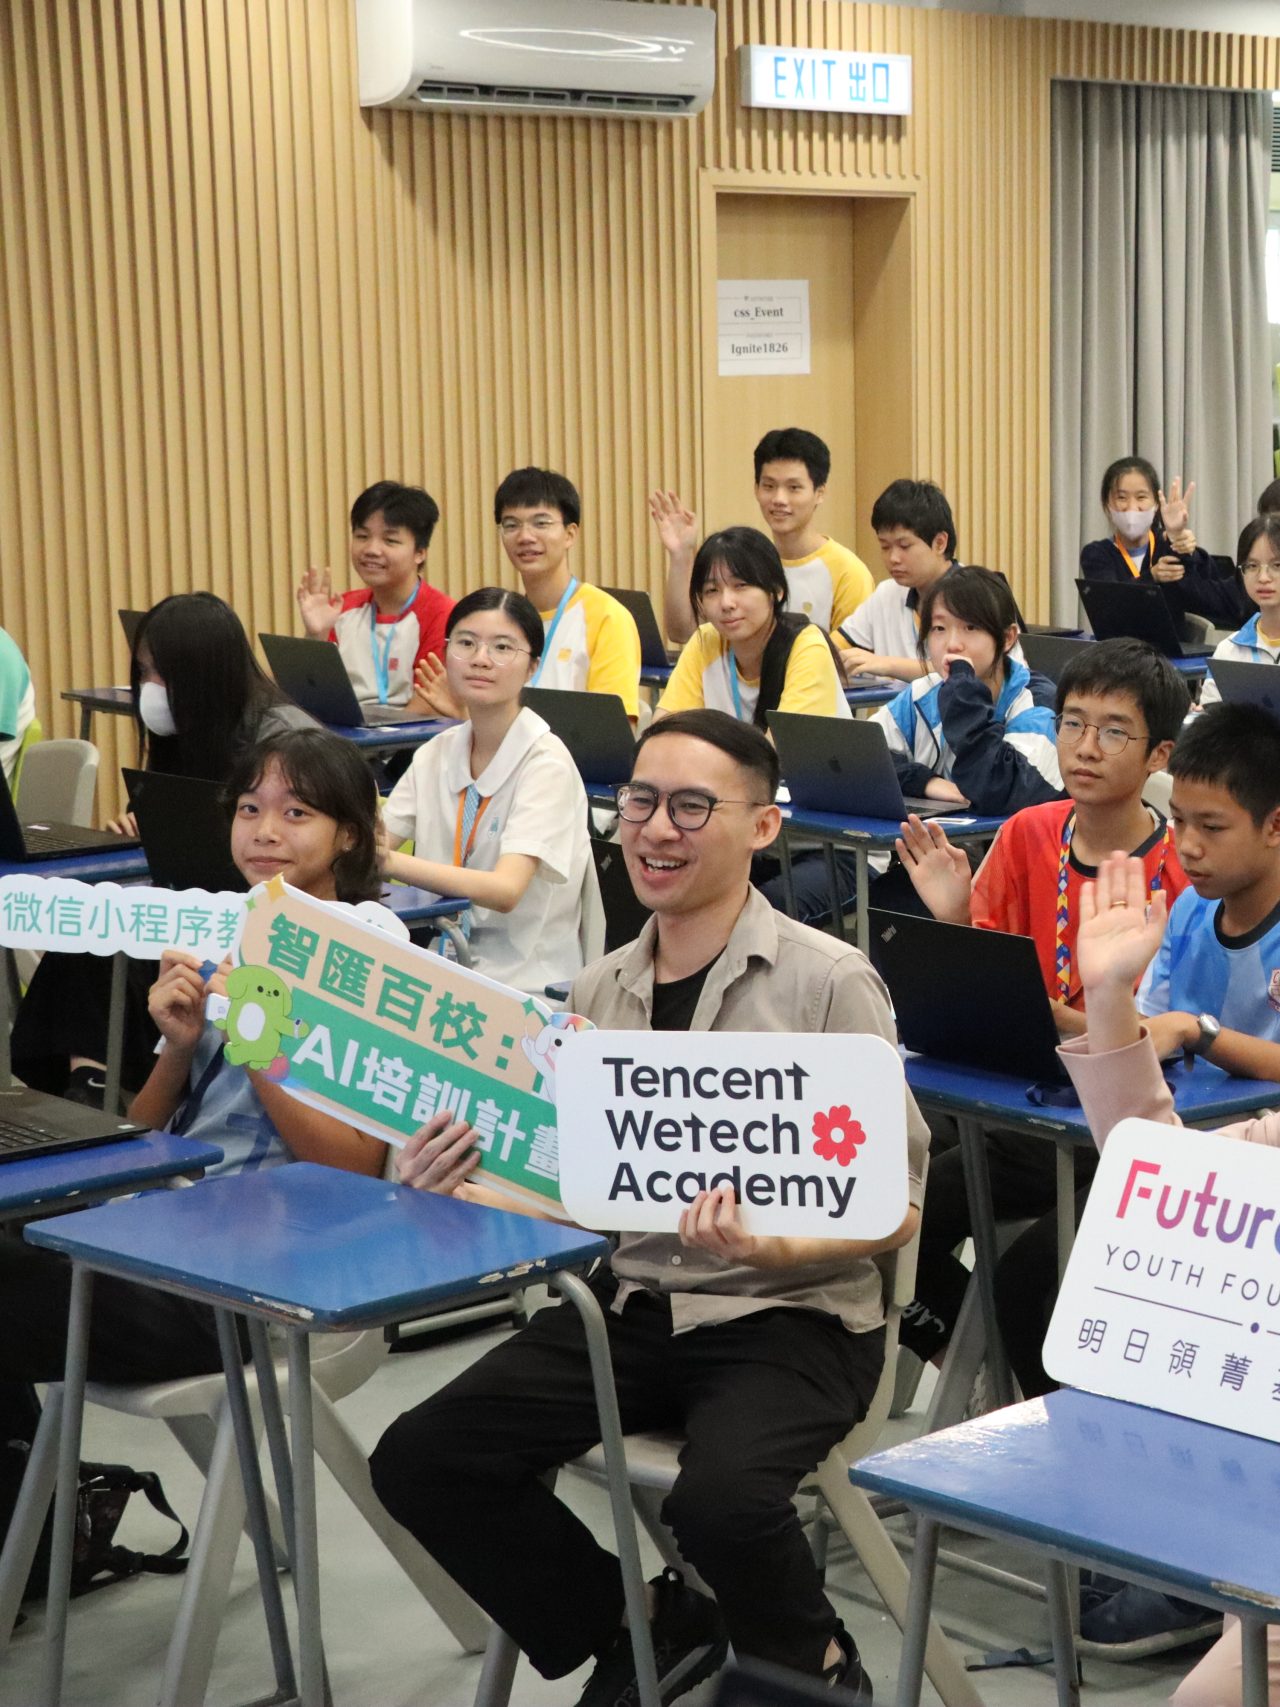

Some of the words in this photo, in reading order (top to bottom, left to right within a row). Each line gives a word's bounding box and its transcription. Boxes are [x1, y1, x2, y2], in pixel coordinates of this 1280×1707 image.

[774, 56, 837, 100] EXIT
[849, 62, 890, 103] 出口
[733, 306, 784, 320] css_Event
[731, 342, 789, 356] Ignite1826
[602, 1057, 811, 1101] Tencent
[605, 1109, 801, 1155] Wetech
[608, 1162, 857, 1219] Academy
[1105, 1243, 1206, 1288] YOUTH
